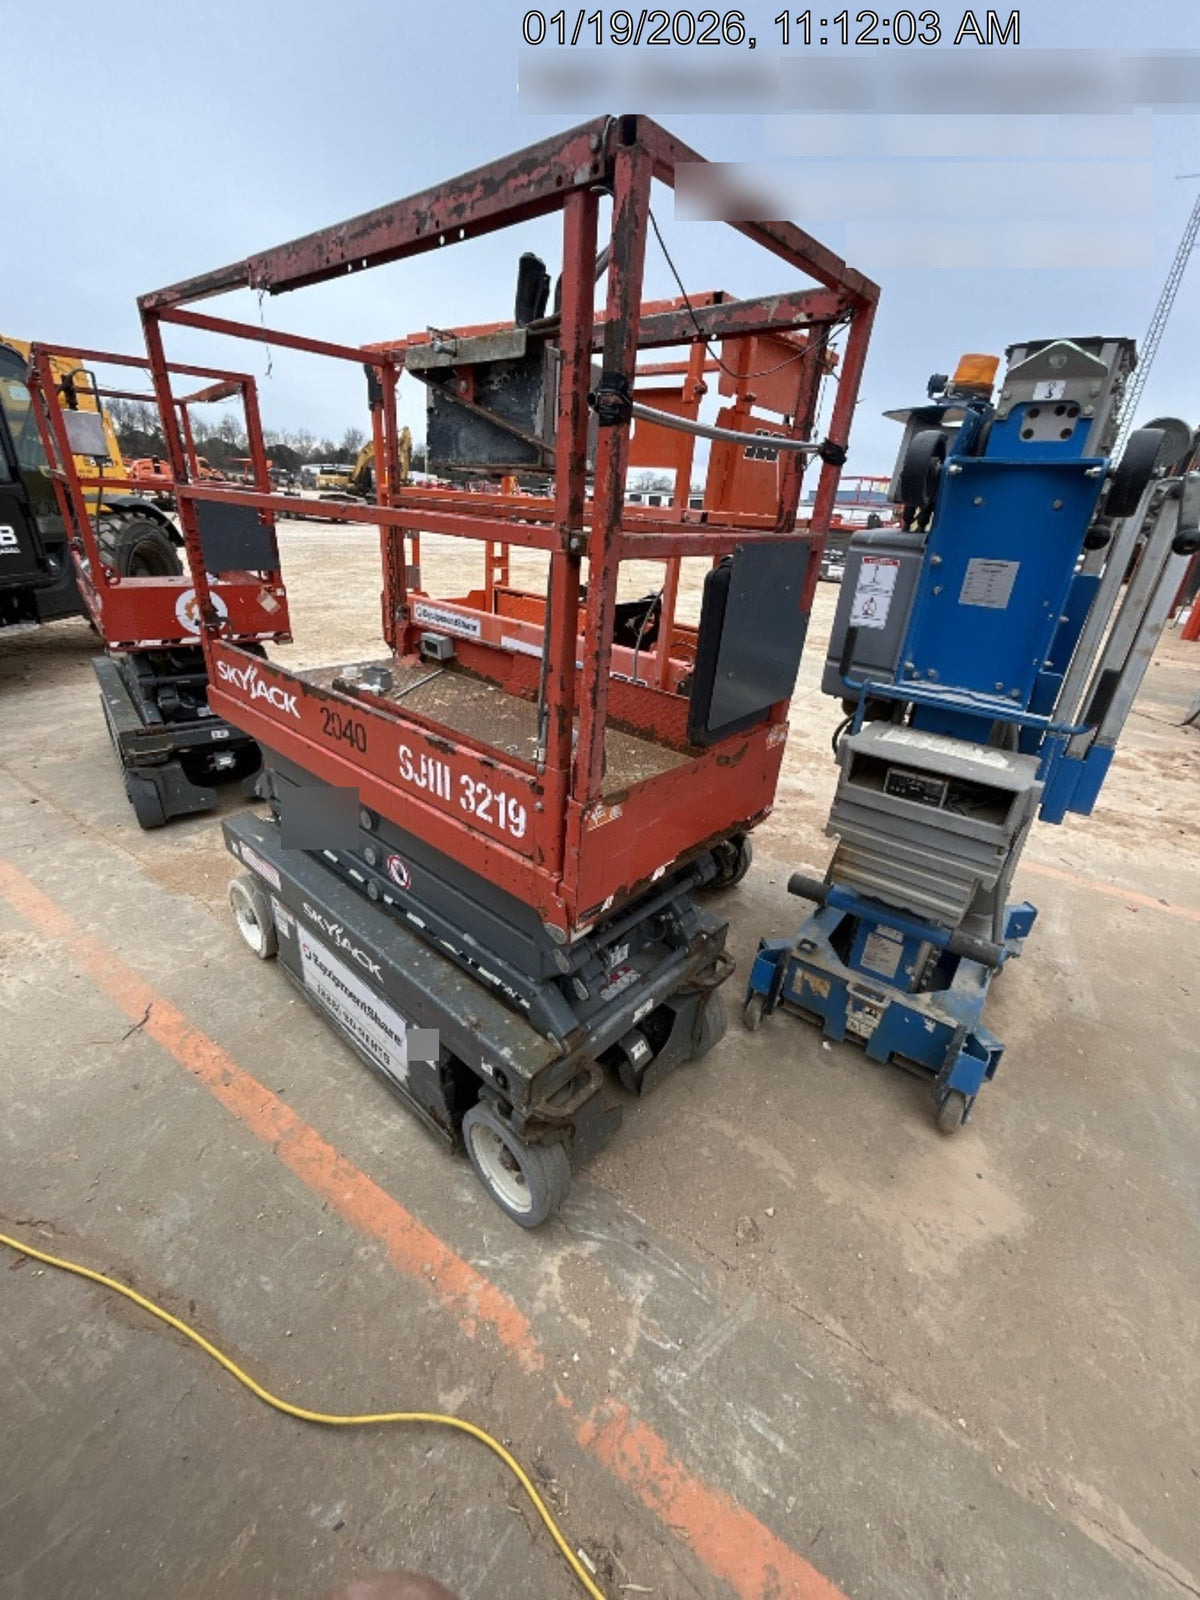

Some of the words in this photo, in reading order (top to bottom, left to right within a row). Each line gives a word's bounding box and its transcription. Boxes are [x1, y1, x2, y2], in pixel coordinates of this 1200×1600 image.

[216, 660, 301, 719] SKYJACK
[320, 706, 367, 753] 2040
[459, 774, 527, 839] 3219
[302, 901, 385, 984] SKYJACK
